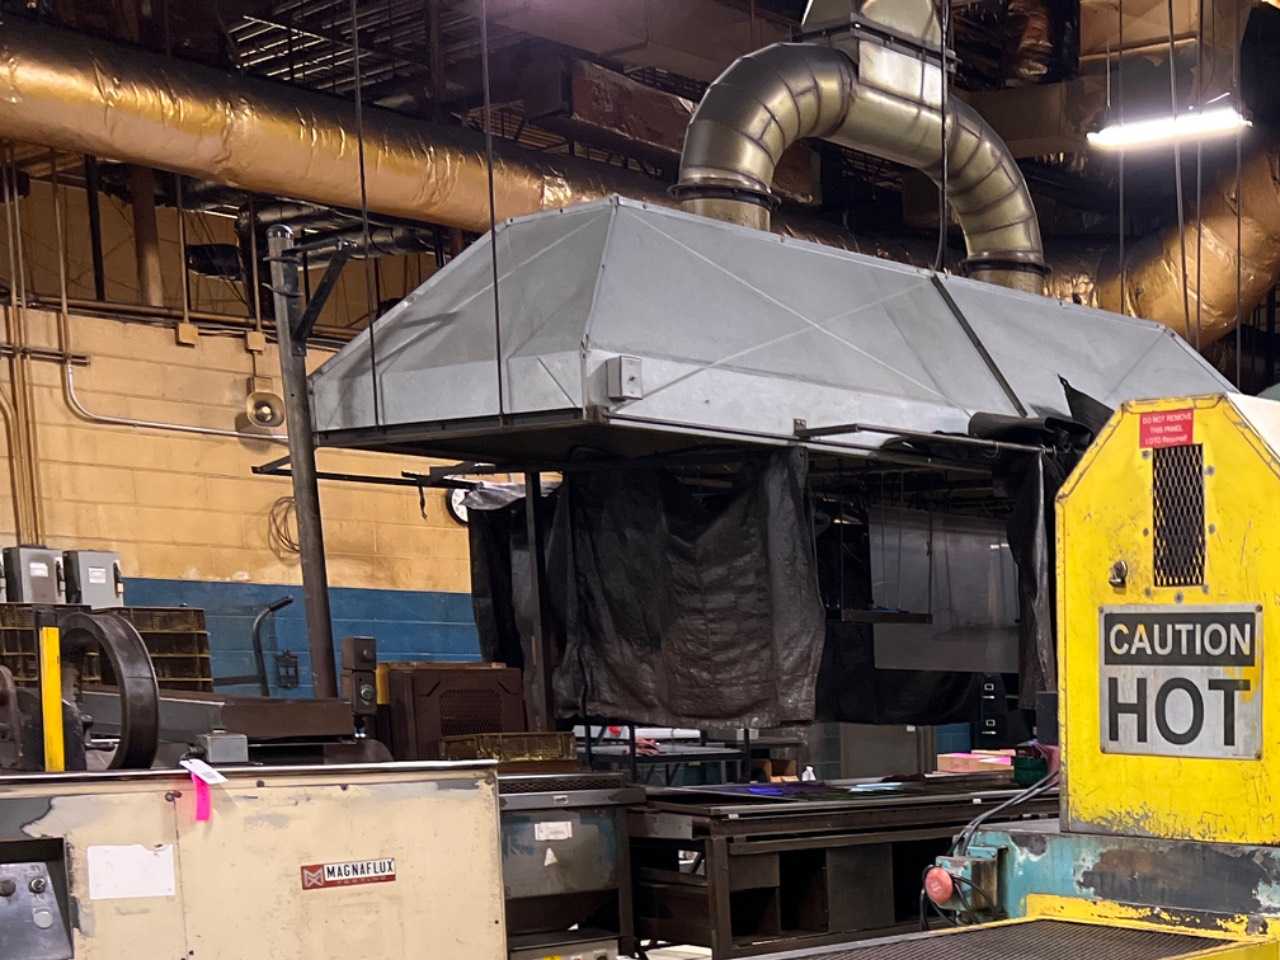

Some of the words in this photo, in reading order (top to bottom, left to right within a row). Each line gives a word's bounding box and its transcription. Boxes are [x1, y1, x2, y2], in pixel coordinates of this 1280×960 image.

[1166, 412, 1192, 422] REMOVE
[1164, 424, 1183, 433] PANEL
[1109, 623, 1251, 656] CAUTION
[1108, 677, 1250, 746] HOT
[326, 860, 395, 879] MAGNAFLUX
